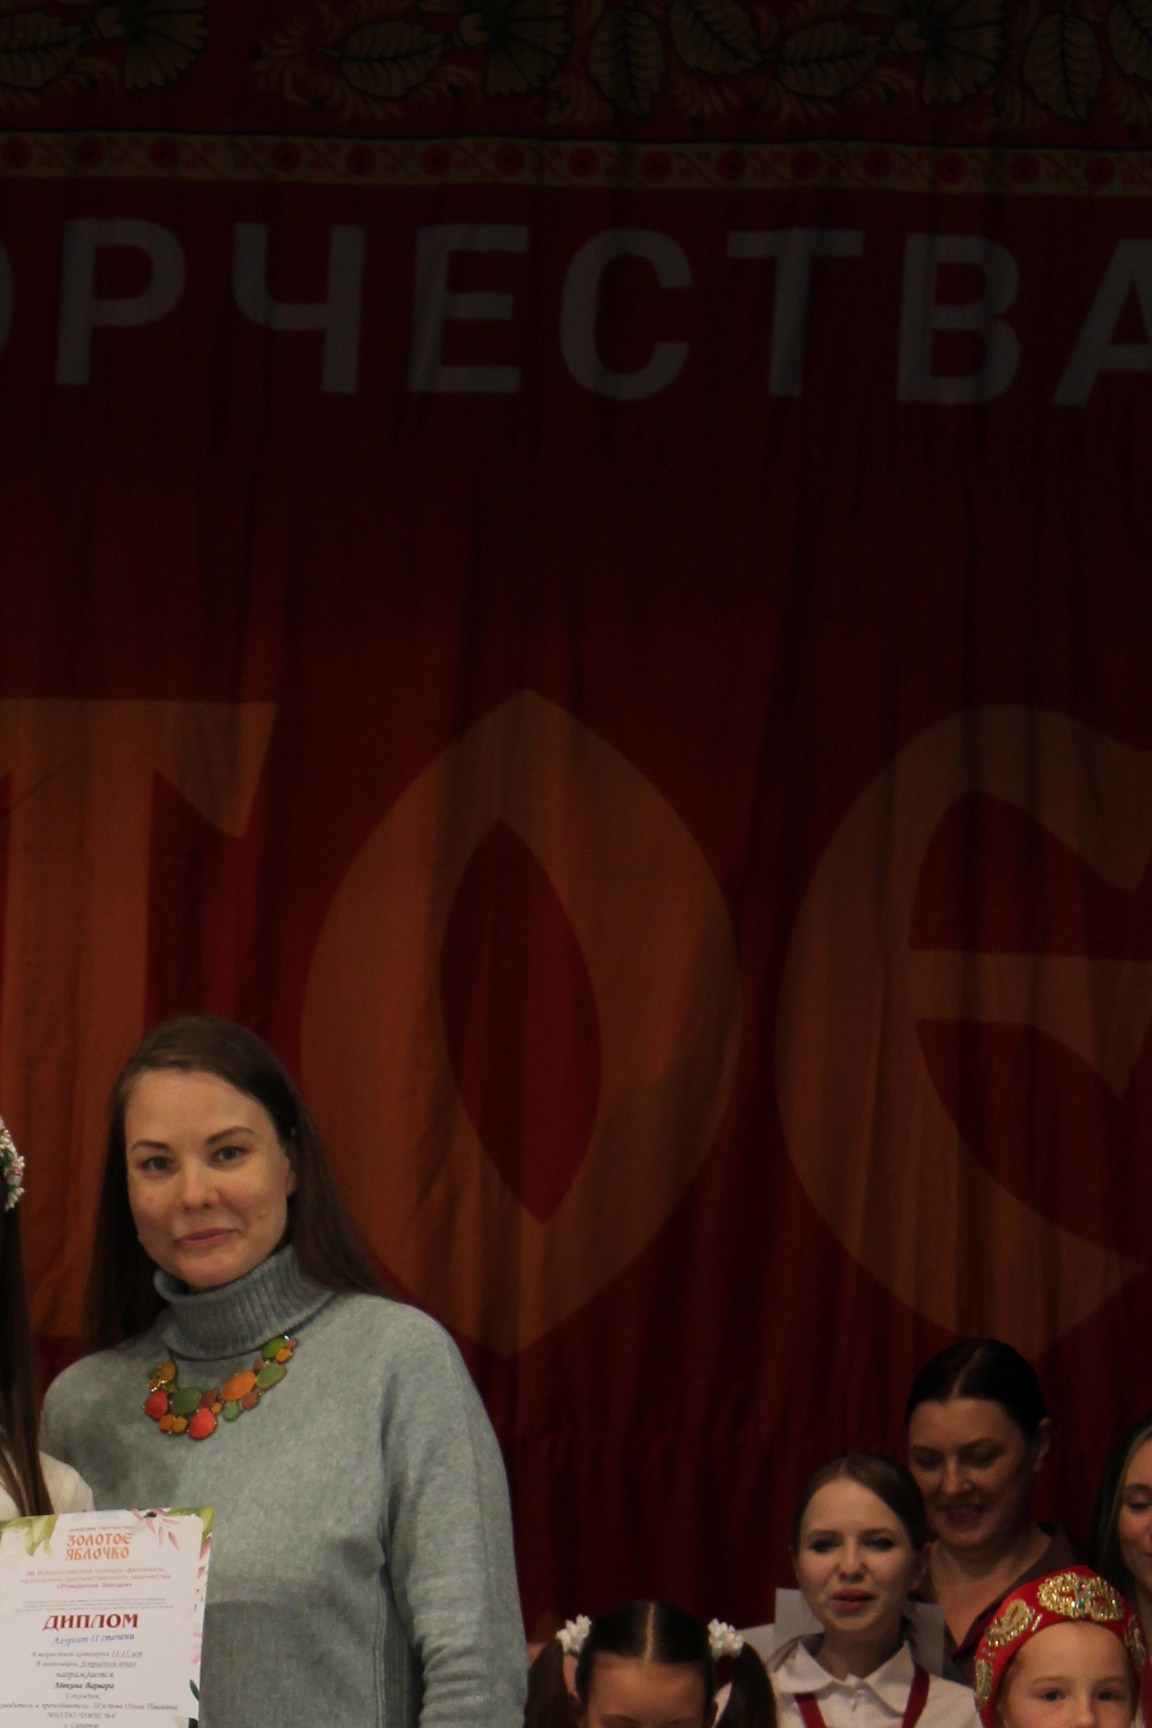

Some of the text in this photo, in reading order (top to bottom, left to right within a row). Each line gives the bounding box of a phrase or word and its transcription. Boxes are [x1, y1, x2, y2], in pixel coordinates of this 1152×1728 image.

[66, 1532, 132, 1547] ЗОЛОТОЕ
[64, 1546, 130, 1560] ЯБЛОЧКО
[42, 1613, 139, 1632] ДИПЛОМ
